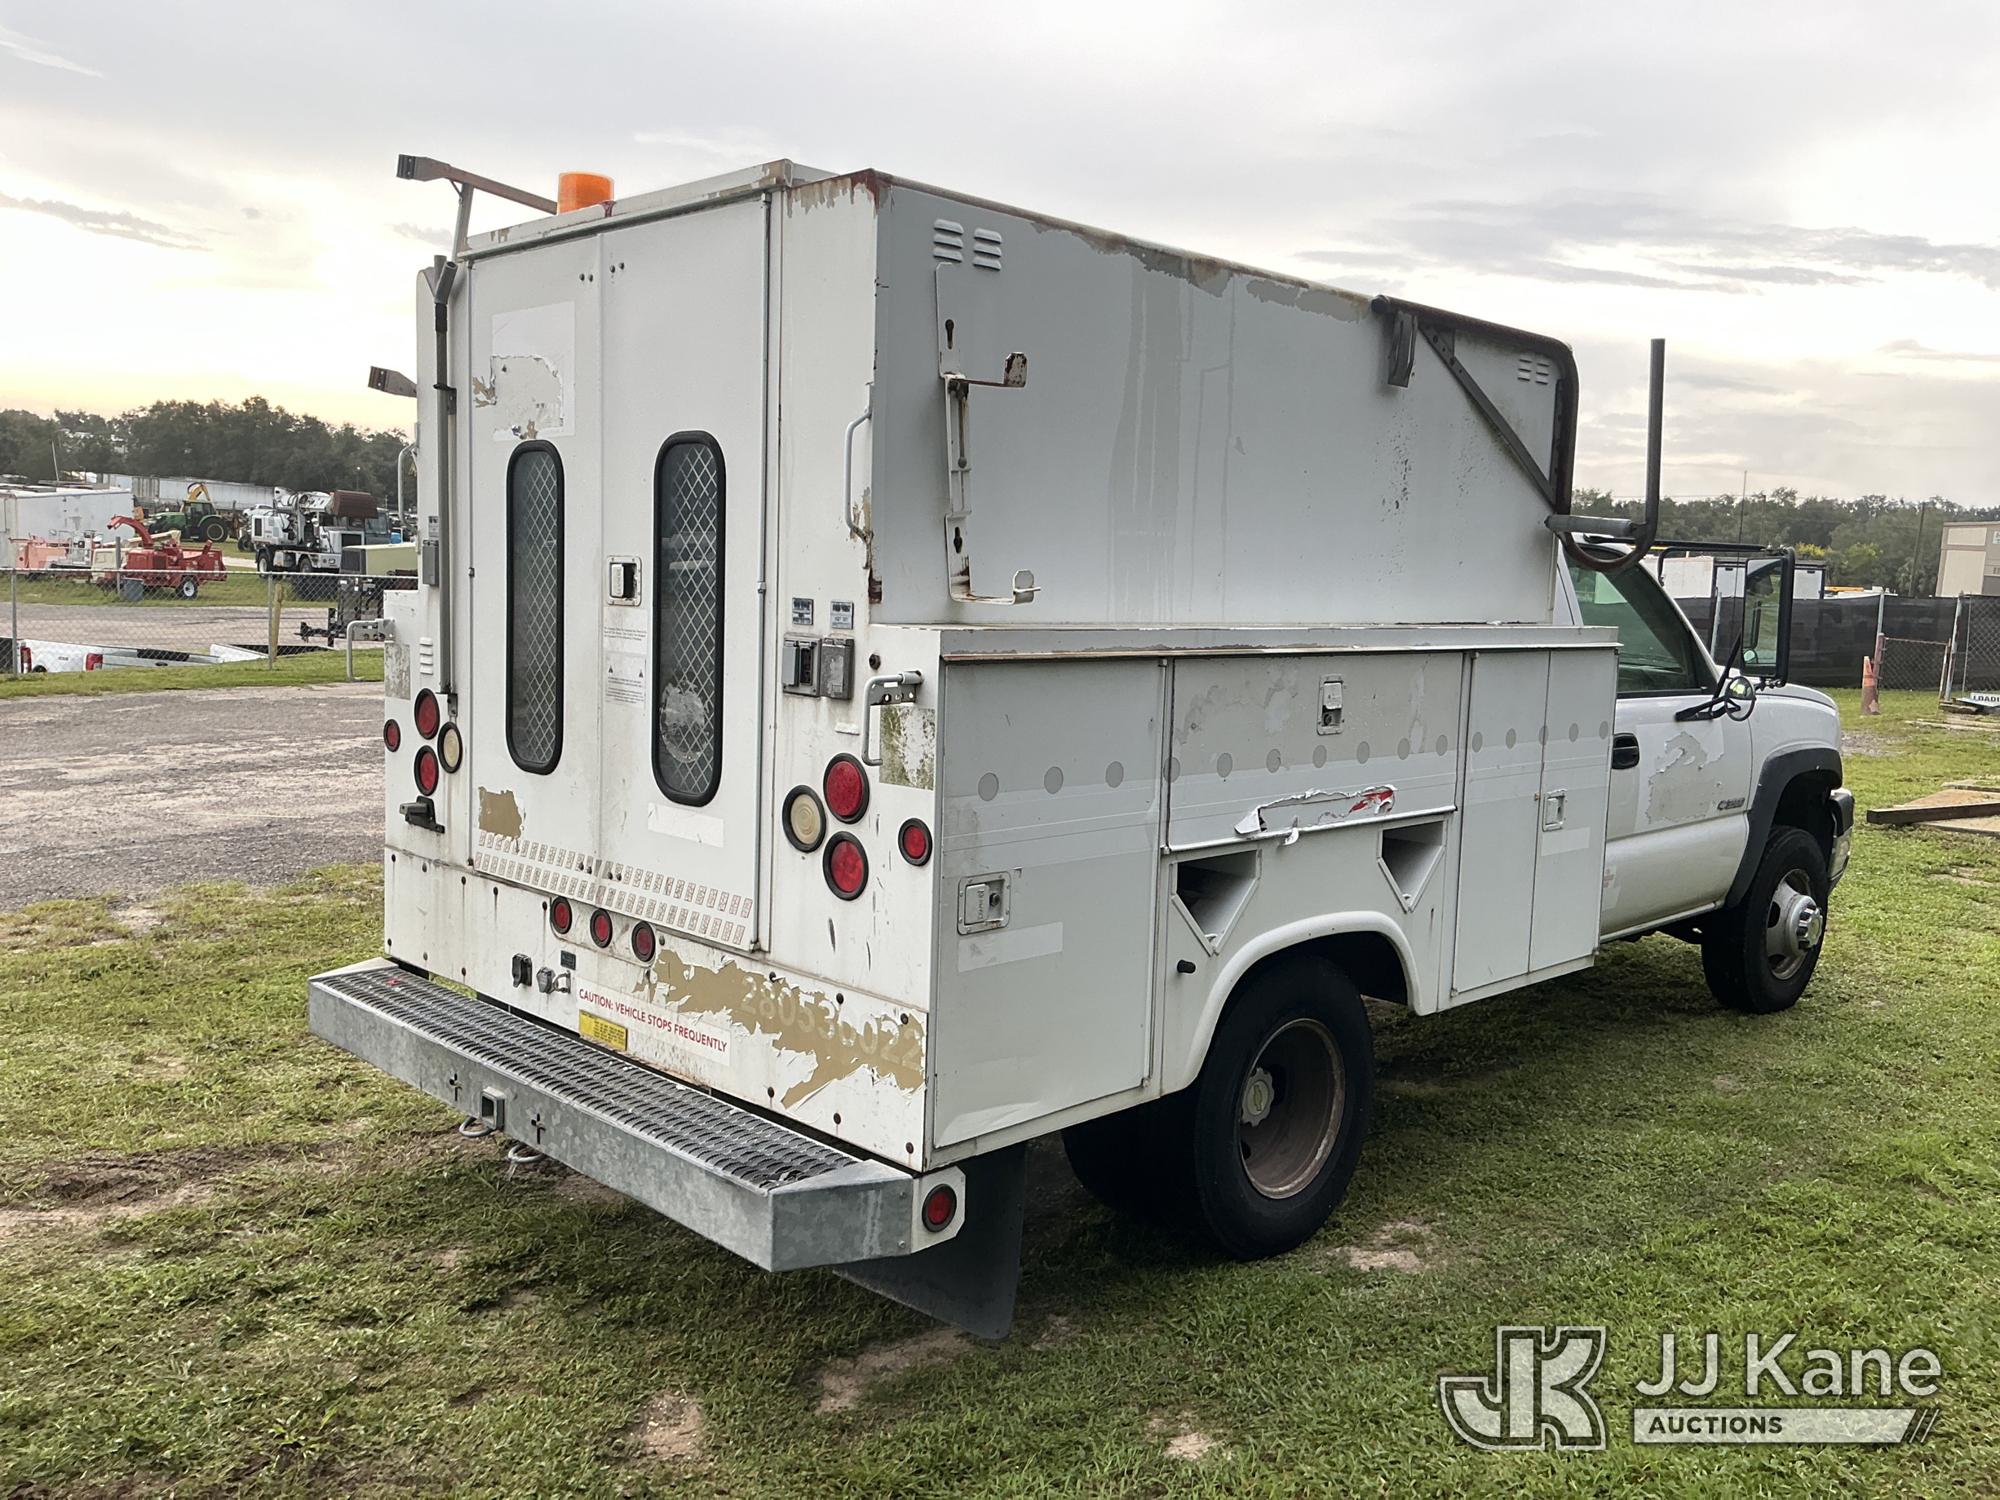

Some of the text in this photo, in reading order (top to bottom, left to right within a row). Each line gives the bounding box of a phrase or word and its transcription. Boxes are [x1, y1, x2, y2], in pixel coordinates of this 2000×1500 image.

[579, 988, 614, 1010] CAUTION:
[615, 1002, 646, 1023] VEHICLE
[647, 1014, 672, 1033] STOPS
[674, 1023, 727, 1053] FREQUENTLY
